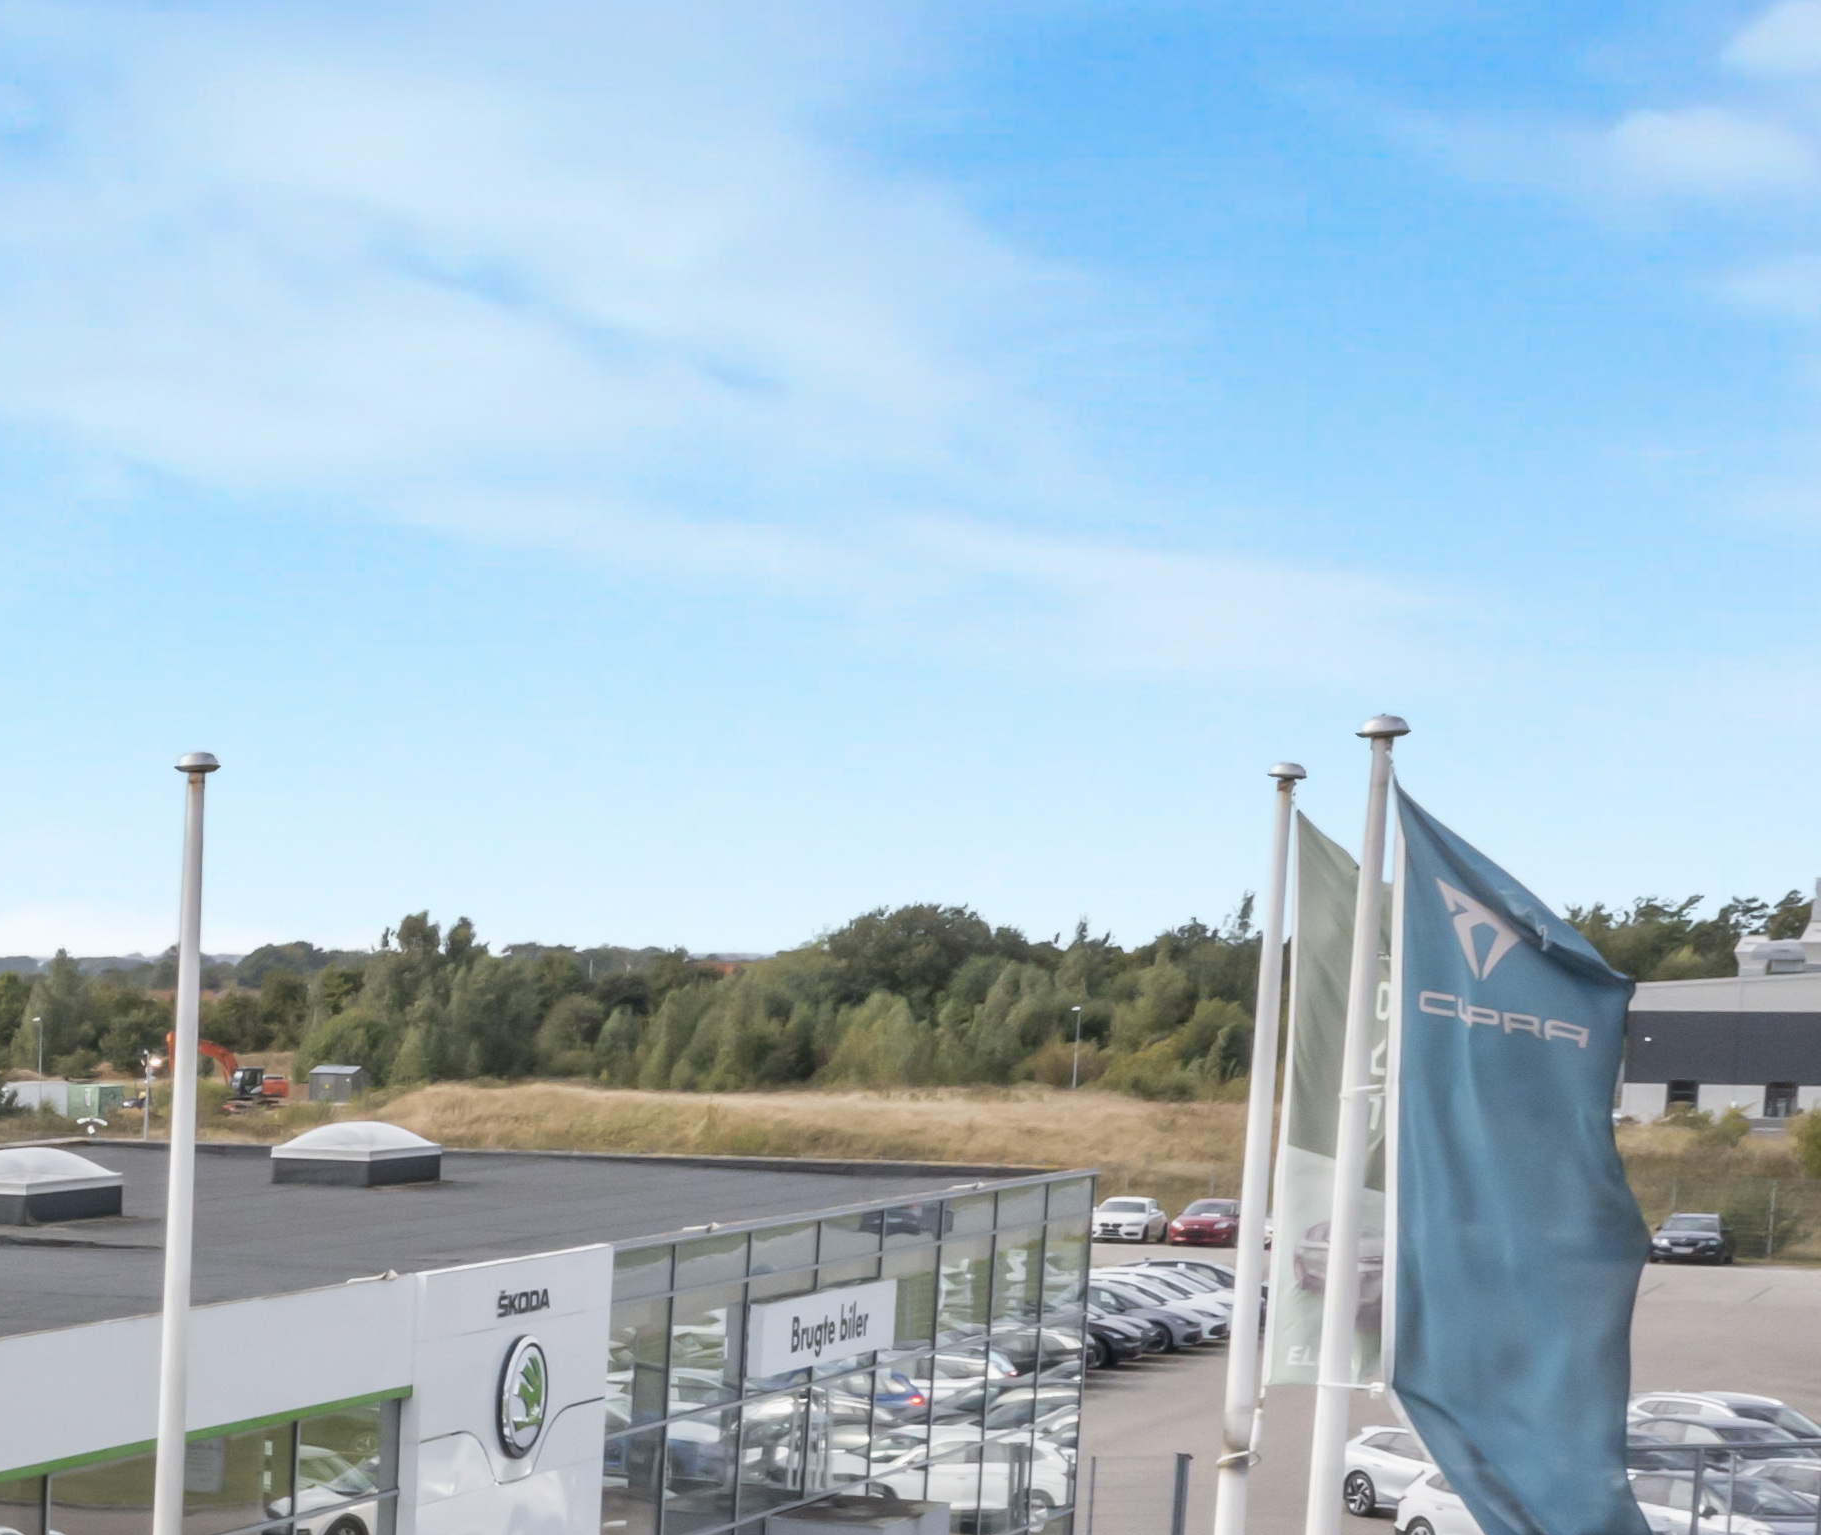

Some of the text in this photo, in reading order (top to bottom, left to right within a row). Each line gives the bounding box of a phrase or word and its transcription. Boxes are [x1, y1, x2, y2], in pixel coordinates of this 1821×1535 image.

[1418, 990, 1590, 1048] CUPRA
[497, 1289, 550, 1318] ŠKODA
[791, 1300, 869, 1358] Brugte biler
